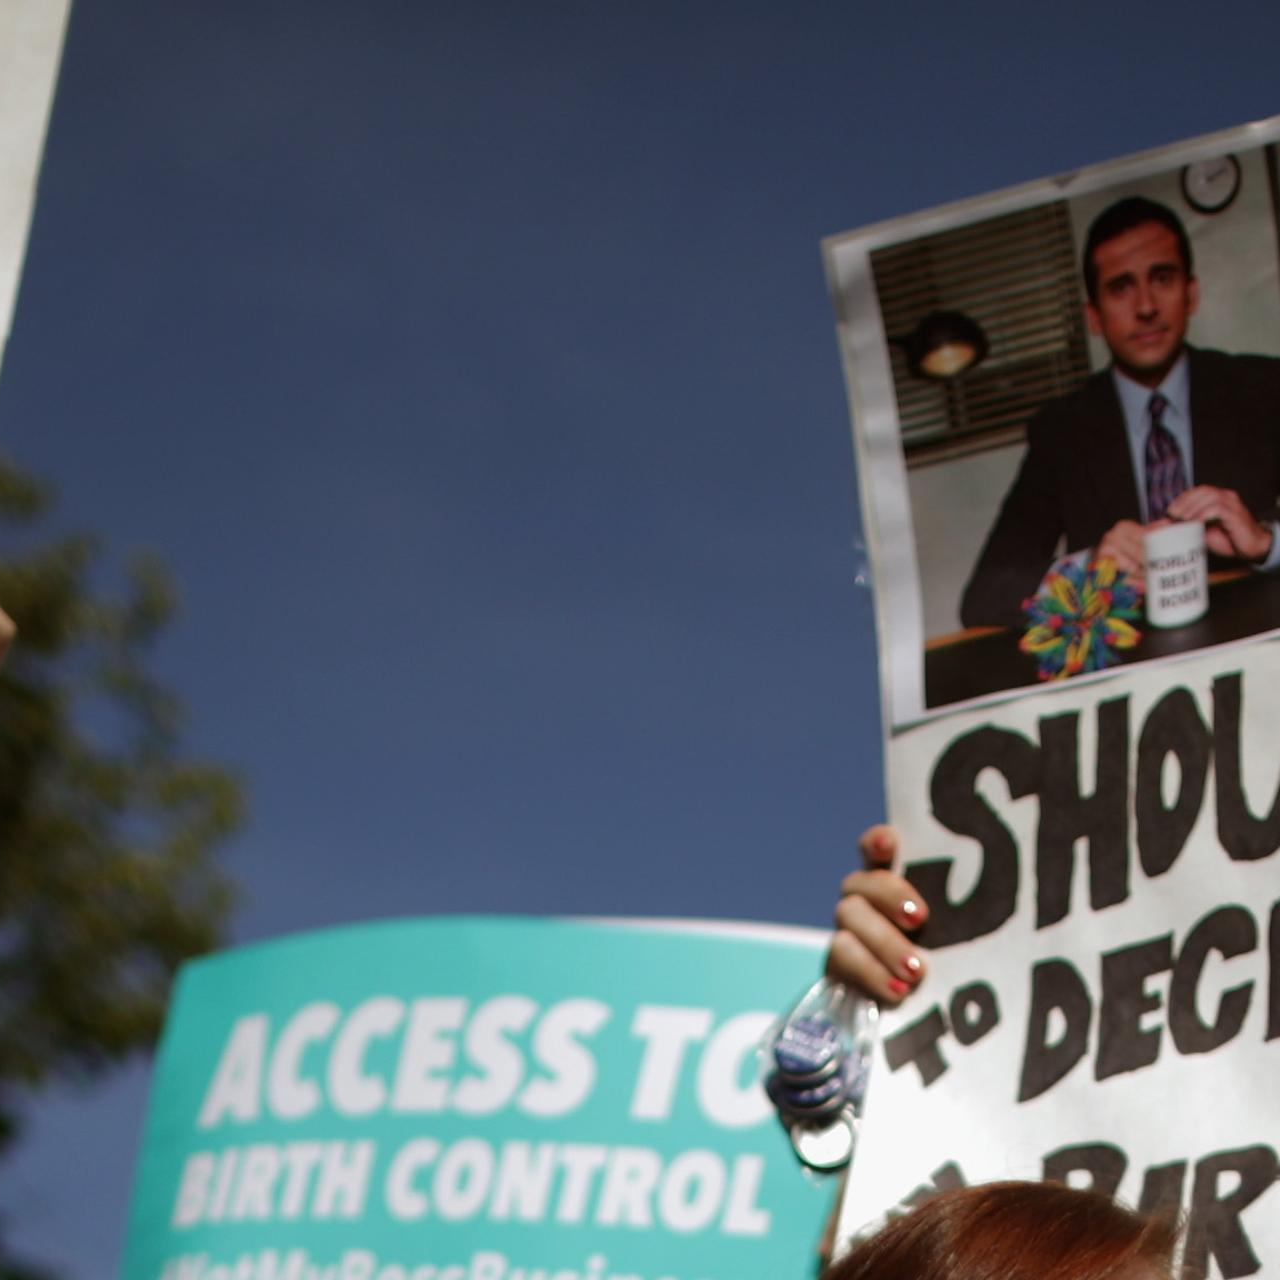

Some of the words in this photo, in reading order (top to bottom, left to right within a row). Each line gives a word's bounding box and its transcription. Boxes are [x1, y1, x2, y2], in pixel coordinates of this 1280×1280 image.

[197, 994, 612, 1131] ACCESS
[882, 980, 1000, 1088] TO
[170, 1139, 377, 1230] BIRTH
[385, 1137, 773, 1237] CONTROL
